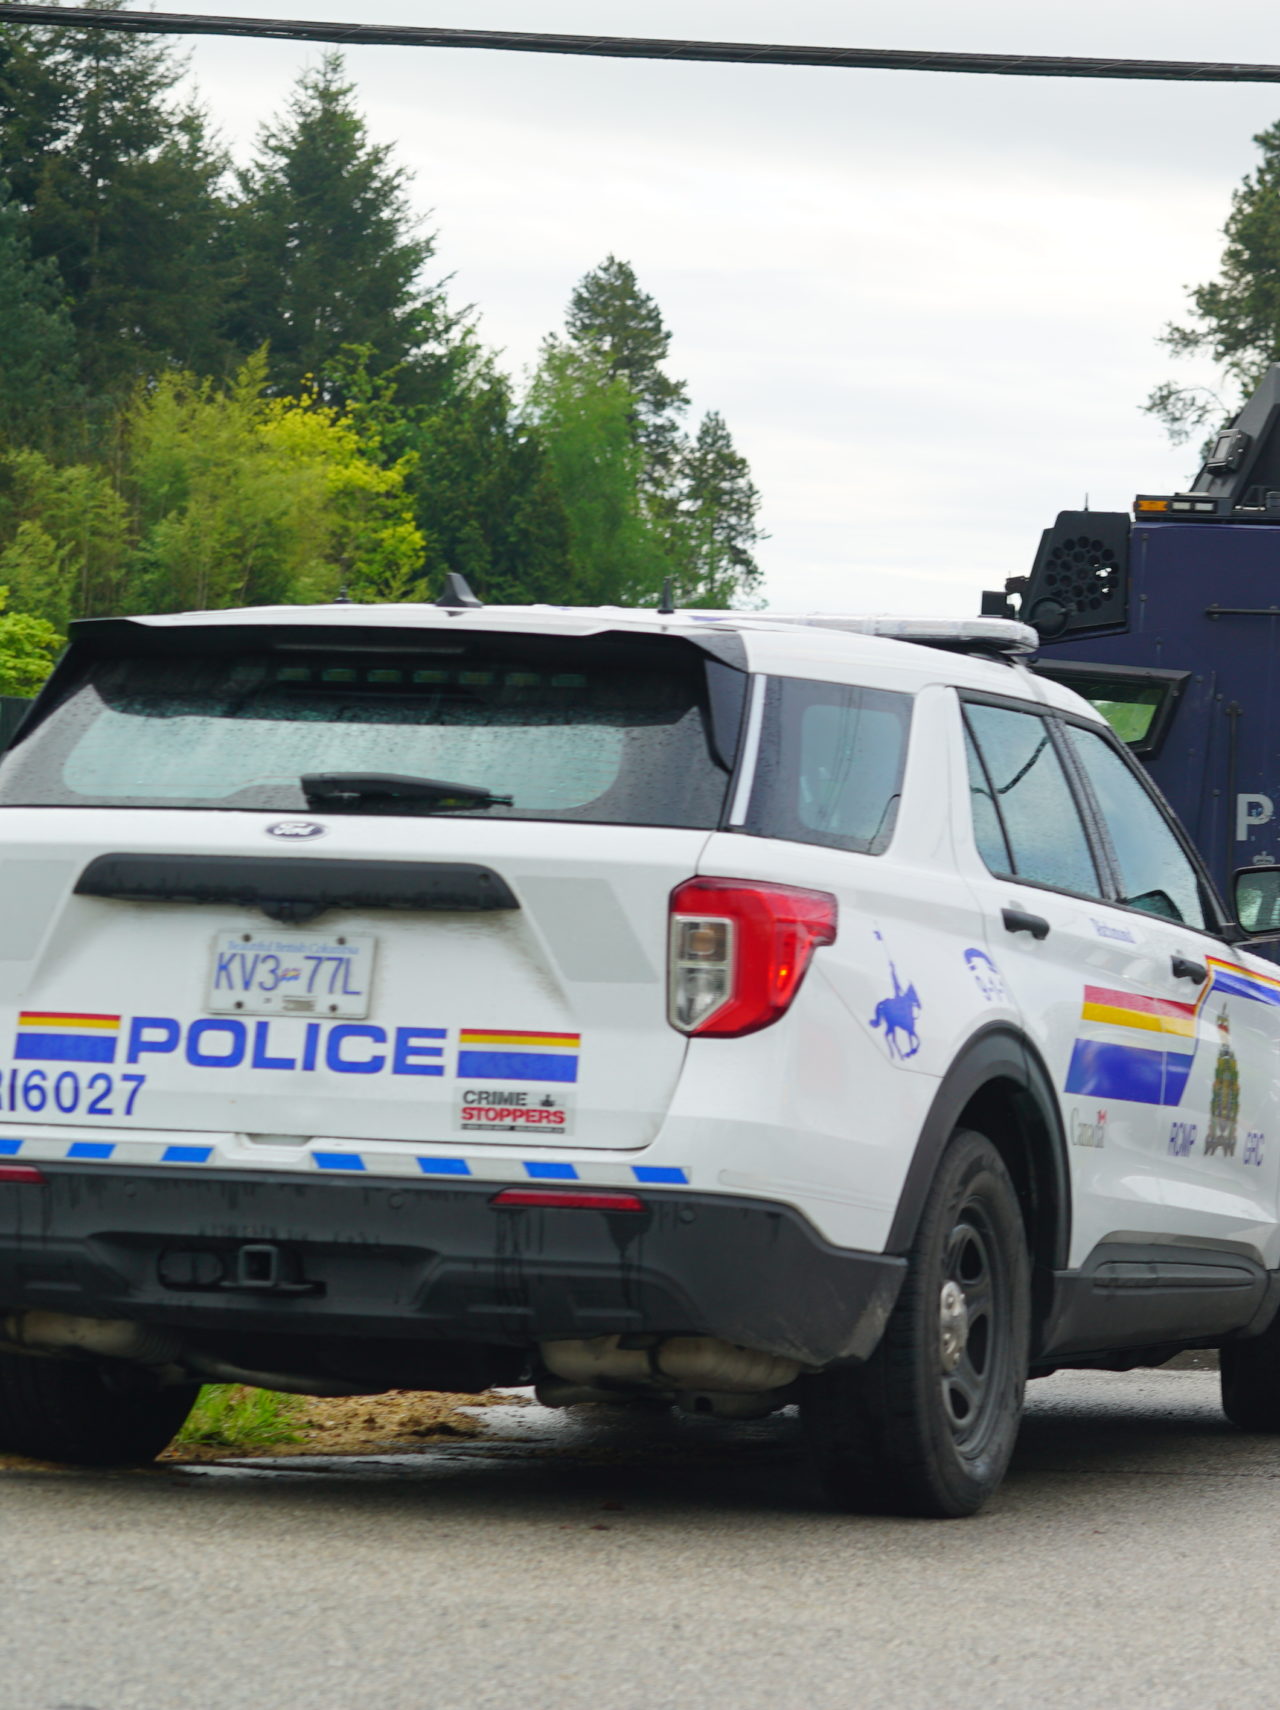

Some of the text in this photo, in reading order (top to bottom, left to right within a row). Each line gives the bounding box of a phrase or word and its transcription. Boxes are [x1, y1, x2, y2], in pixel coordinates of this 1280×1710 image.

[215, 952, 362, 995] KV3 77L
[126, 1016, 448, 1077] POLICE
[0, 1067, 146, 1116] I6027
[462, 1090, 528, 1107] CRIME
[461, 1106, 566, 1125] STOPPERS
[1167, 1121, 1198, 1157] RCMP
